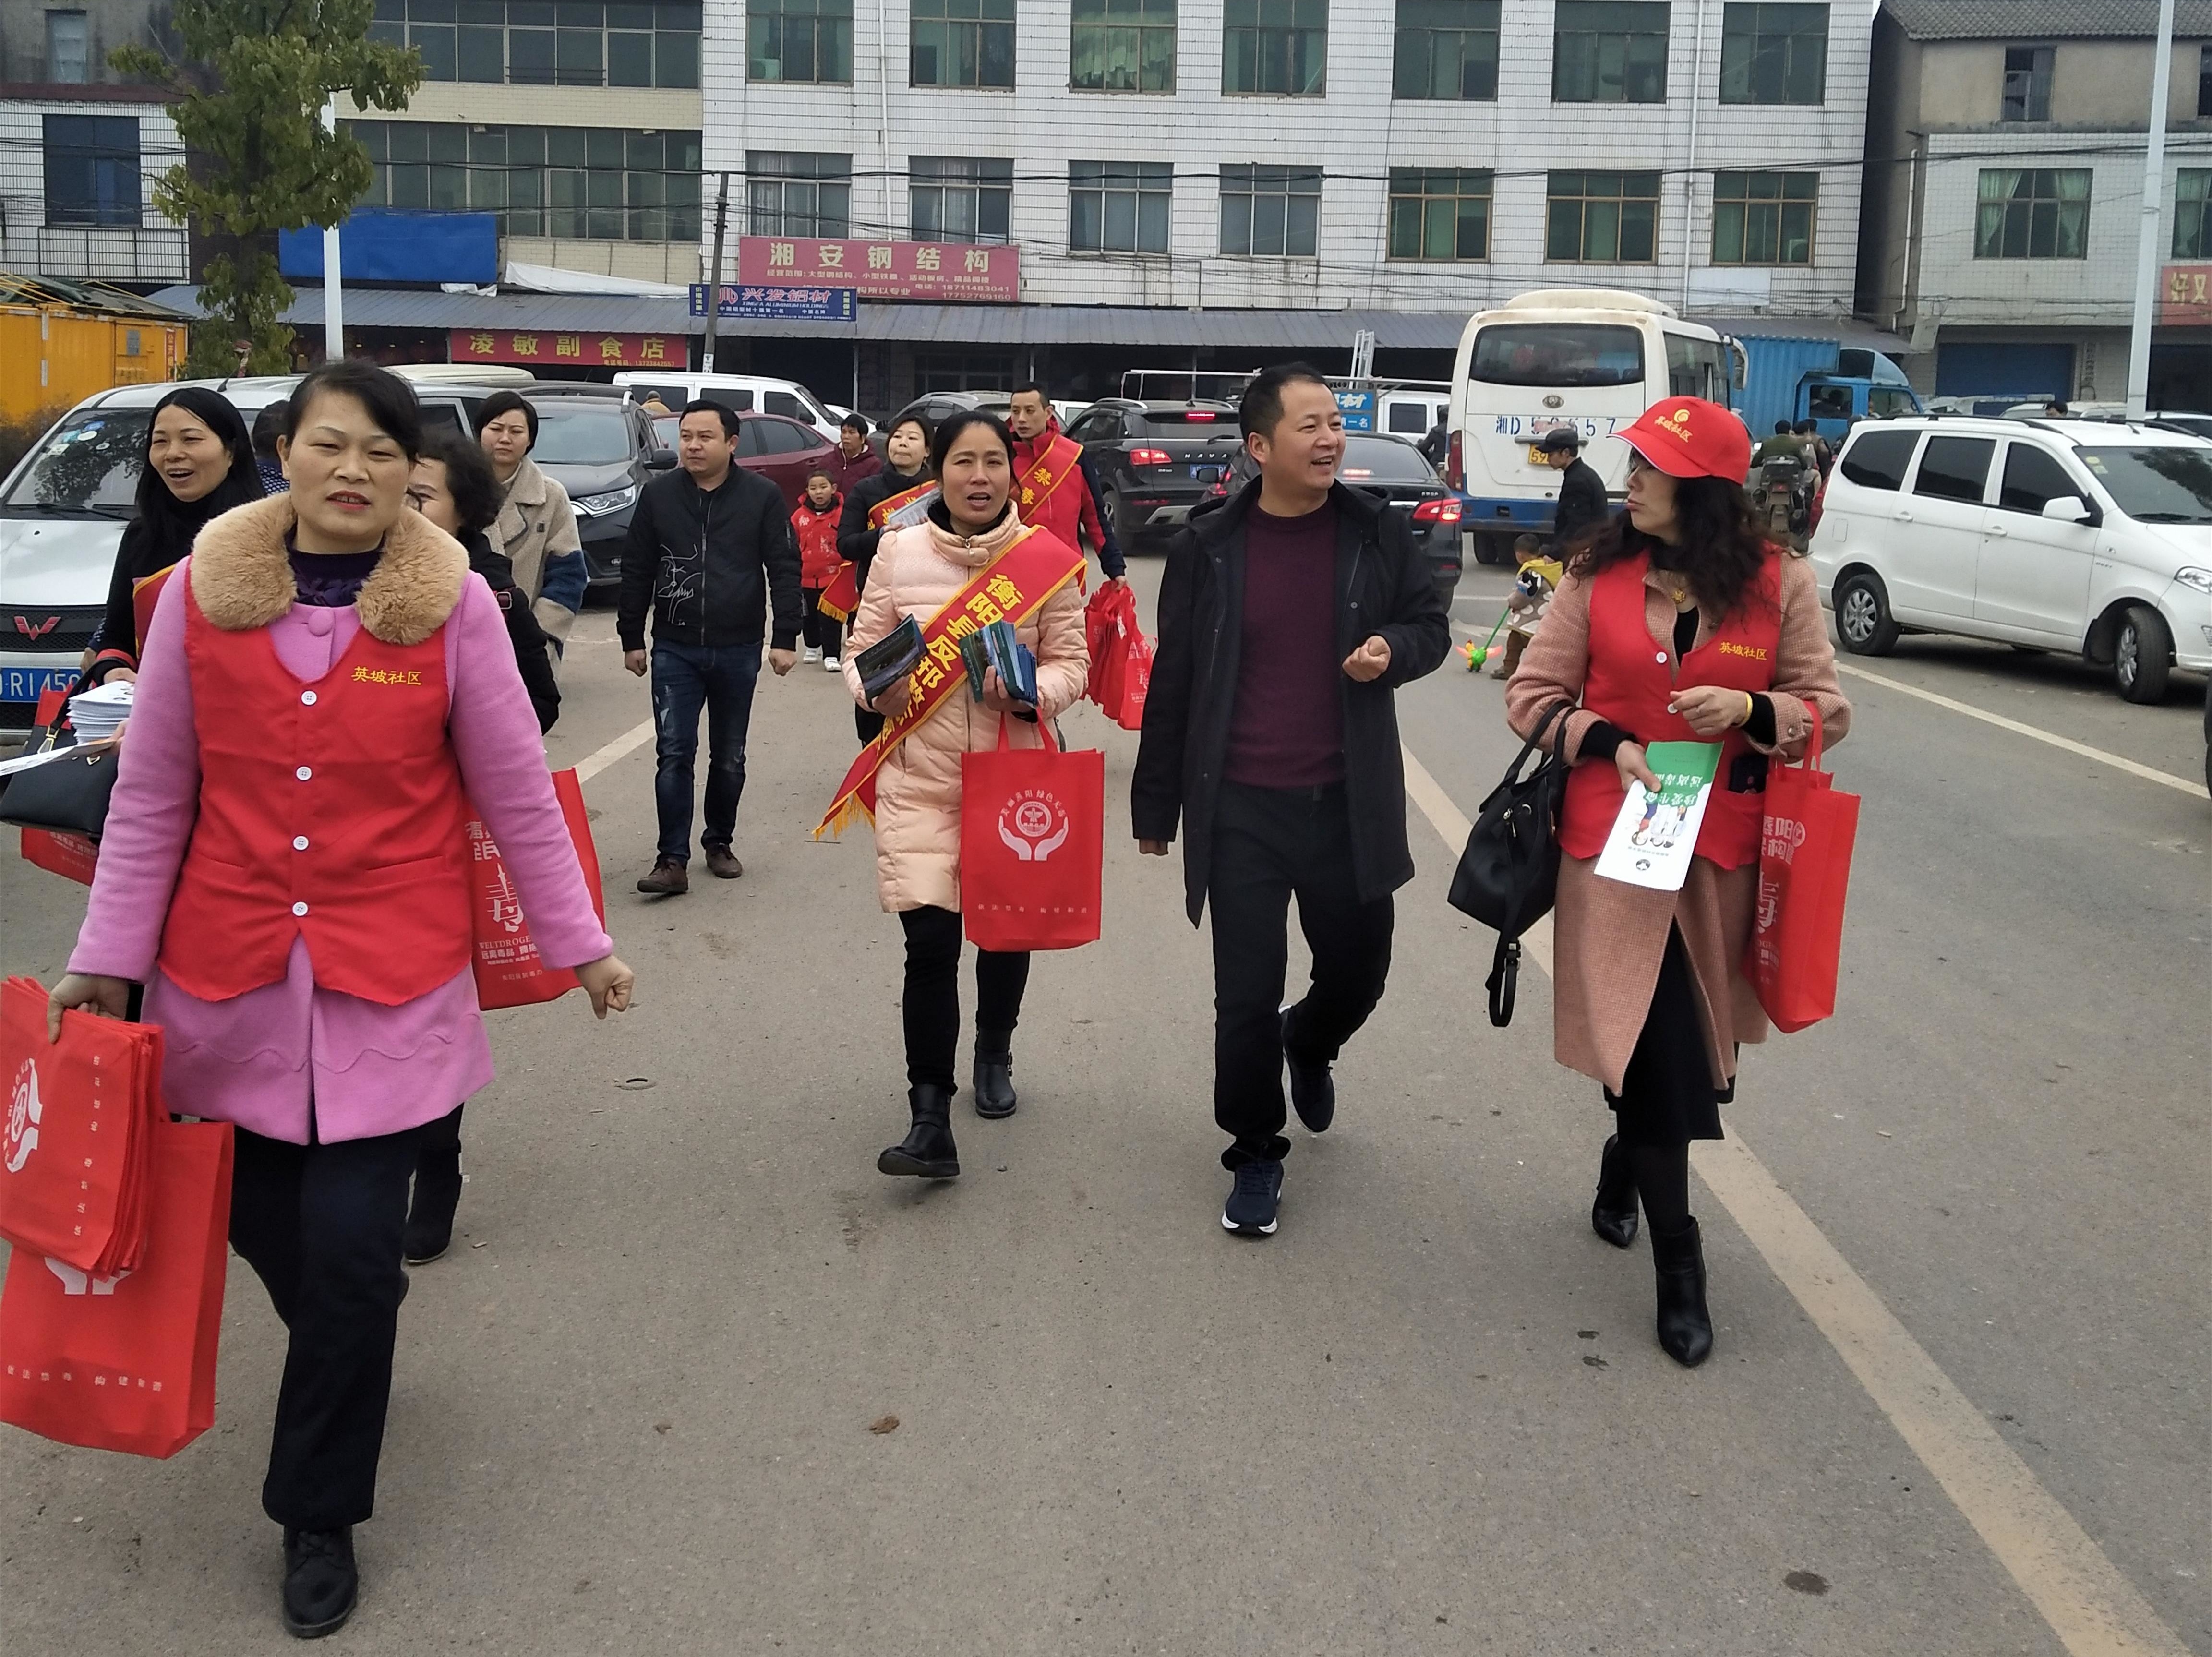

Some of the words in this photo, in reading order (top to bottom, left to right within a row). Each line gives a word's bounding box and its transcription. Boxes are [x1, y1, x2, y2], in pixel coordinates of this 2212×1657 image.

[769, 242, 989, 273] 湘安钢结构
[741, 288, 832, 304] 兴发铝材
[469, 333, 665, 359] 凌敏副食店
[1021, 467, 1053, 505] 禁毒
[1719, 641, 1767, 660] 英坡社区
[351, 666, 422, 685] 英坡社区
